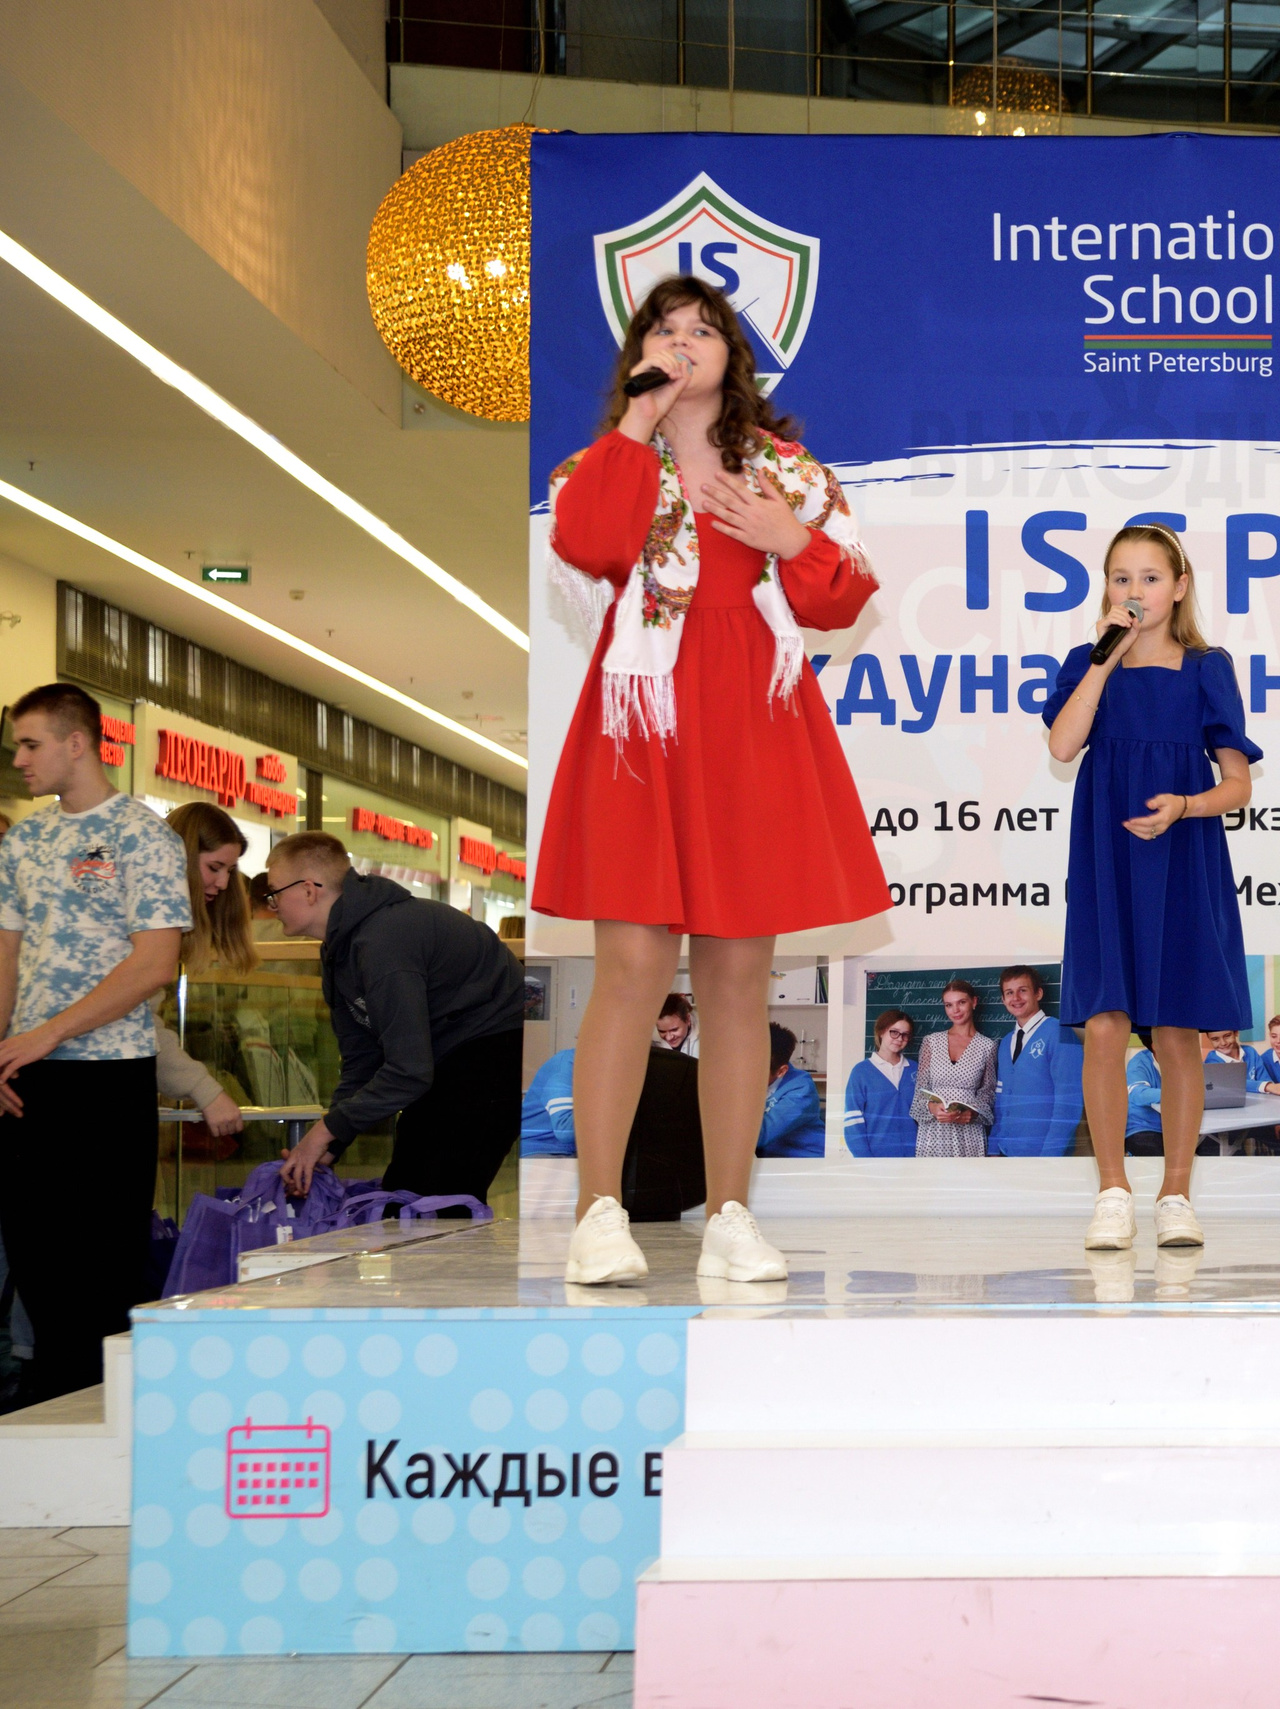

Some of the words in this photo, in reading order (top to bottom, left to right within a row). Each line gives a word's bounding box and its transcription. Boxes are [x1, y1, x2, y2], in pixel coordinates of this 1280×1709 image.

[1084, 274, 1273, 324] School
[1084, 352, 1142, 373] Saint
[1149, 352, 1273, 377] Petersburg
[101, 713, 136, 747] УКОДЕЛИЕ
[157, 729, 247, 808] ЛЕОНАРДО
[870, 808, 919, 836] до
[934, 800, 981, 831] 16
[994, 808, 1060, 832] лет
[887, 882, 1050, 914] ограмма
[366, 1439, 620, 1507] Каждые
